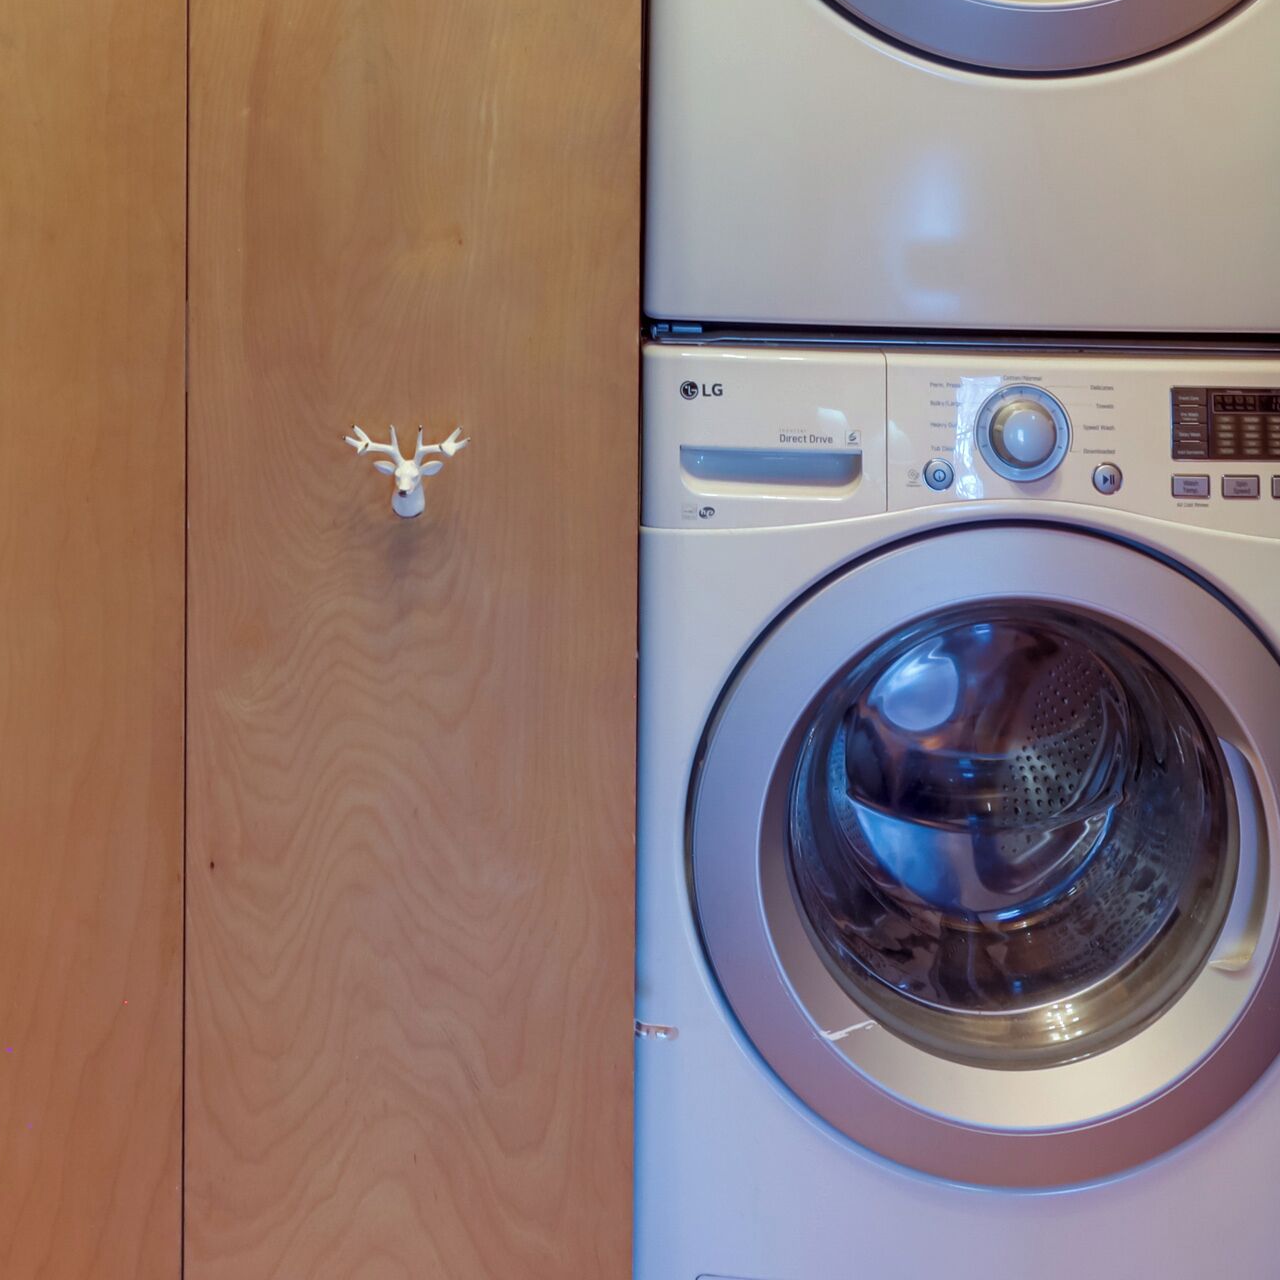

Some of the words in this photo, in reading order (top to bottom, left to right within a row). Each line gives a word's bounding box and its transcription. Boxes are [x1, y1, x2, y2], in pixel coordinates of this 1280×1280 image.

[702, 383, 724, 397] LG
[779, 434, 807, 444] Direct
[809, 434, 834, 444] Drive
